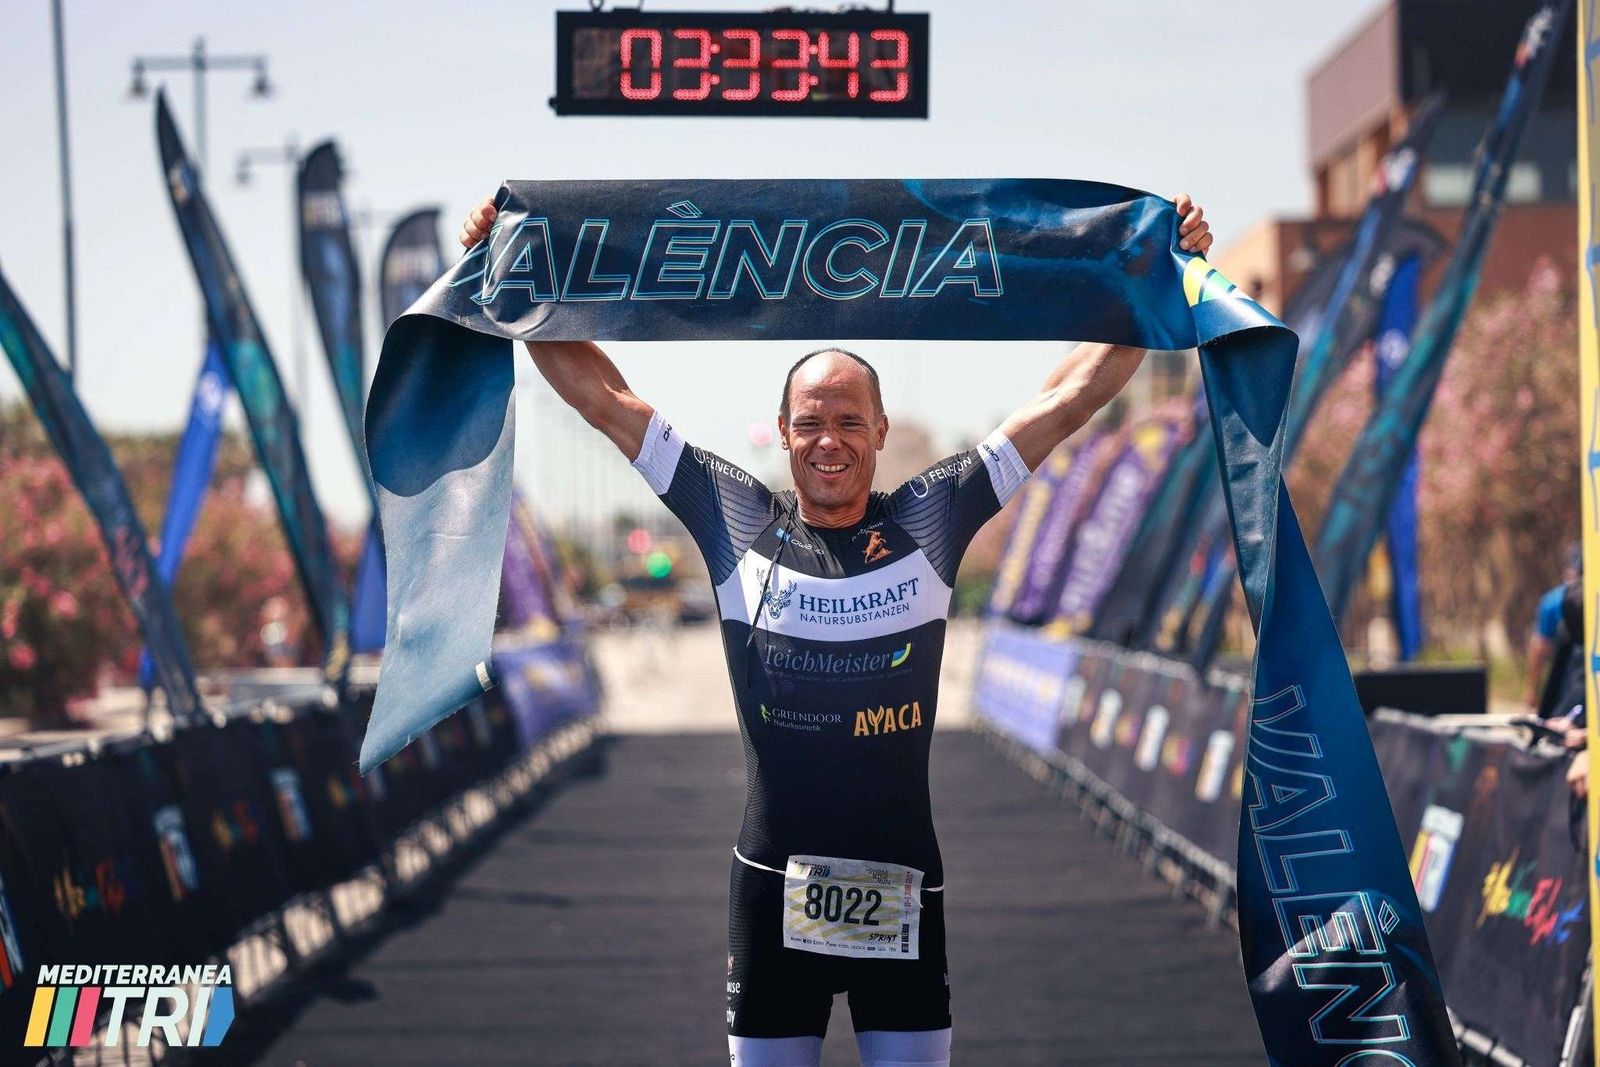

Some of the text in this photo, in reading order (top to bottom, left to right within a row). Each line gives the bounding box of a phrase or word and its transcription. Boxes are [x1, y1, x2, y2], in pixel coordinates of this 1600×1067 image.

[619, 28, 909, 101] 03:33:43
[706, 456, 754, 488] ENECON
[799, 577, 919, 614] HEILKRAFT
[800, 602, 910, 625] NATURSUBSTANZEN
[765, 643, 890, 674] TeichMeister
[772, 707, 843, 724] GREENDOOR
[854, 701, 922, 737] AYACA
[1246, 684, 1417, 1067] VALÈN
[804, 883, 882, 926] 8022
[868, 933, 898, 944] SPRINT
